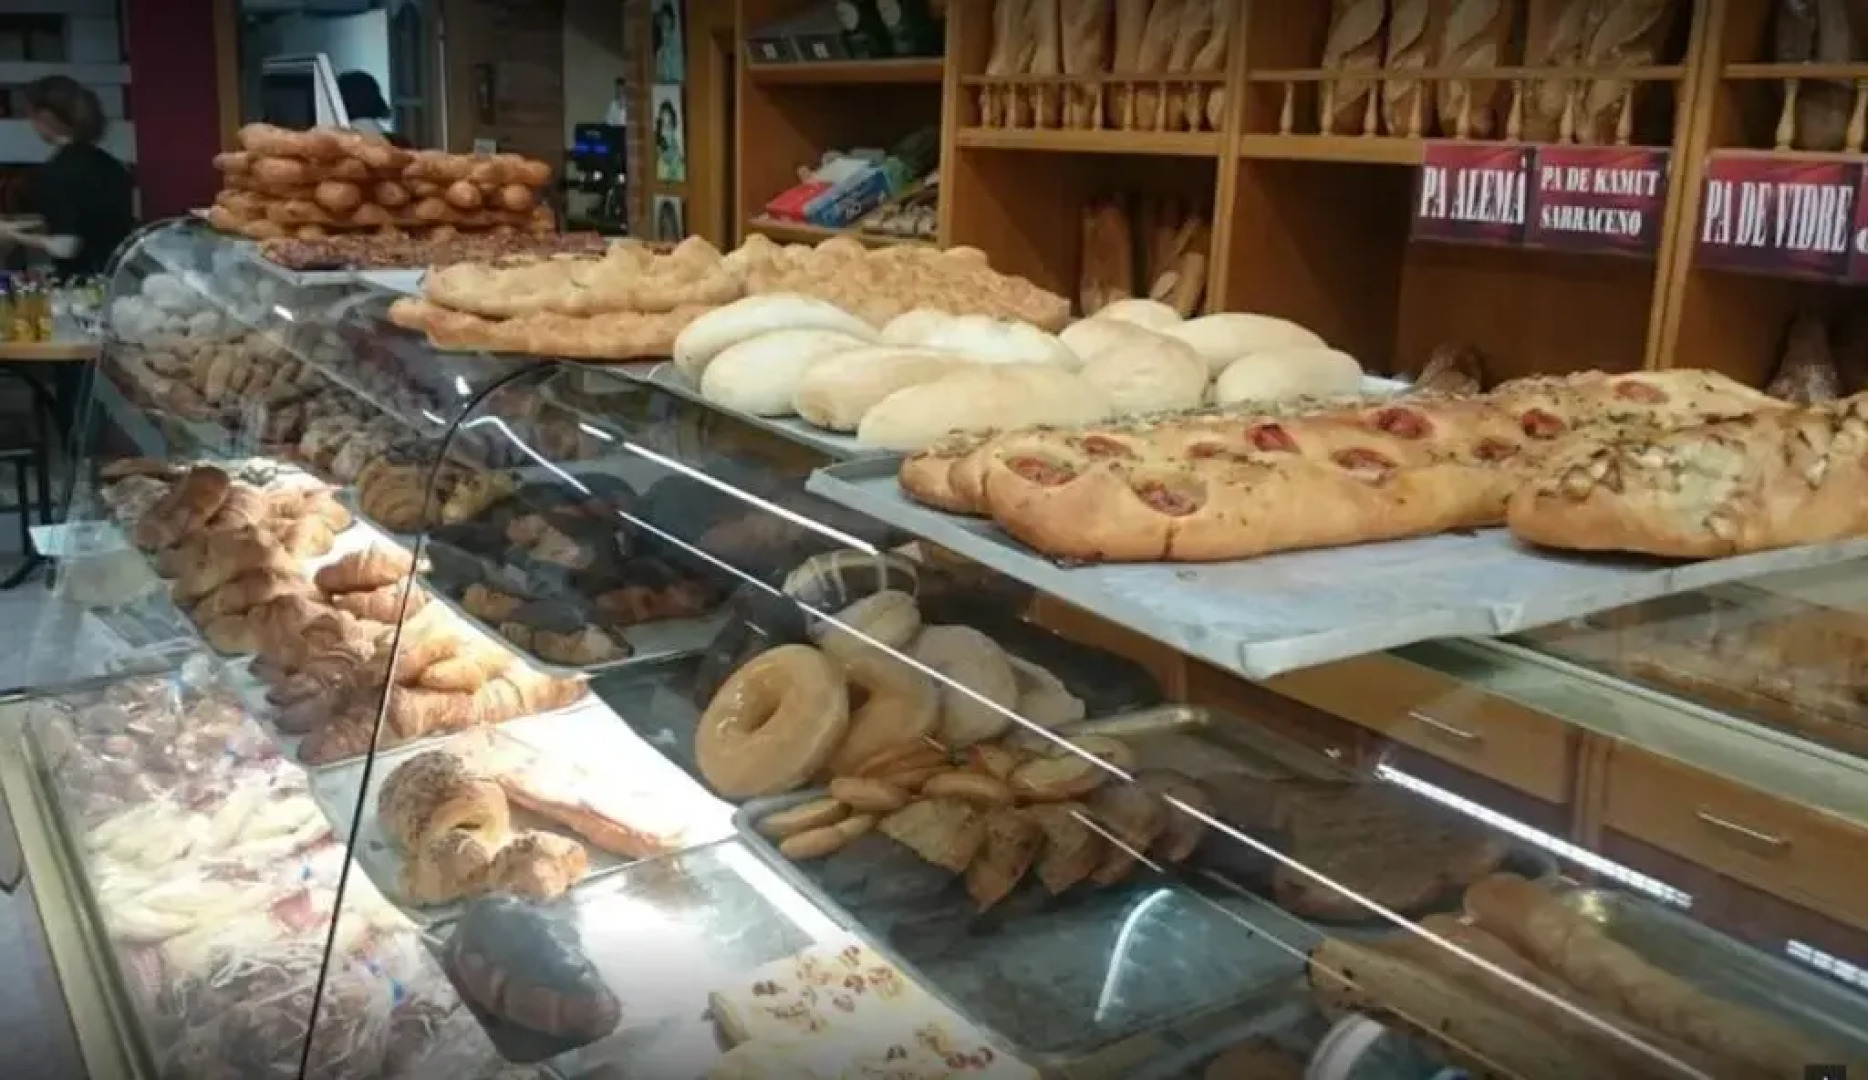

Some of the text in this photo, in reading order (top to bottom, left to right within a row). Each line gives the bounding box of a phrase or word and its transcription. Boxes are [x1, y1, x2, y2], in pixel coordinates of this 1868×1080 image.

[1420, 166, 1447, 218] PA
[1541, 165, 1660, 196] PA DE KAMUT
[1540, 205, 1642, 236] SARRACENO
[1702, 180, 1733, 244] PA
[1735, 182, 1771, 247] DE
[1774, 182, 1853, 253] VIDRE
